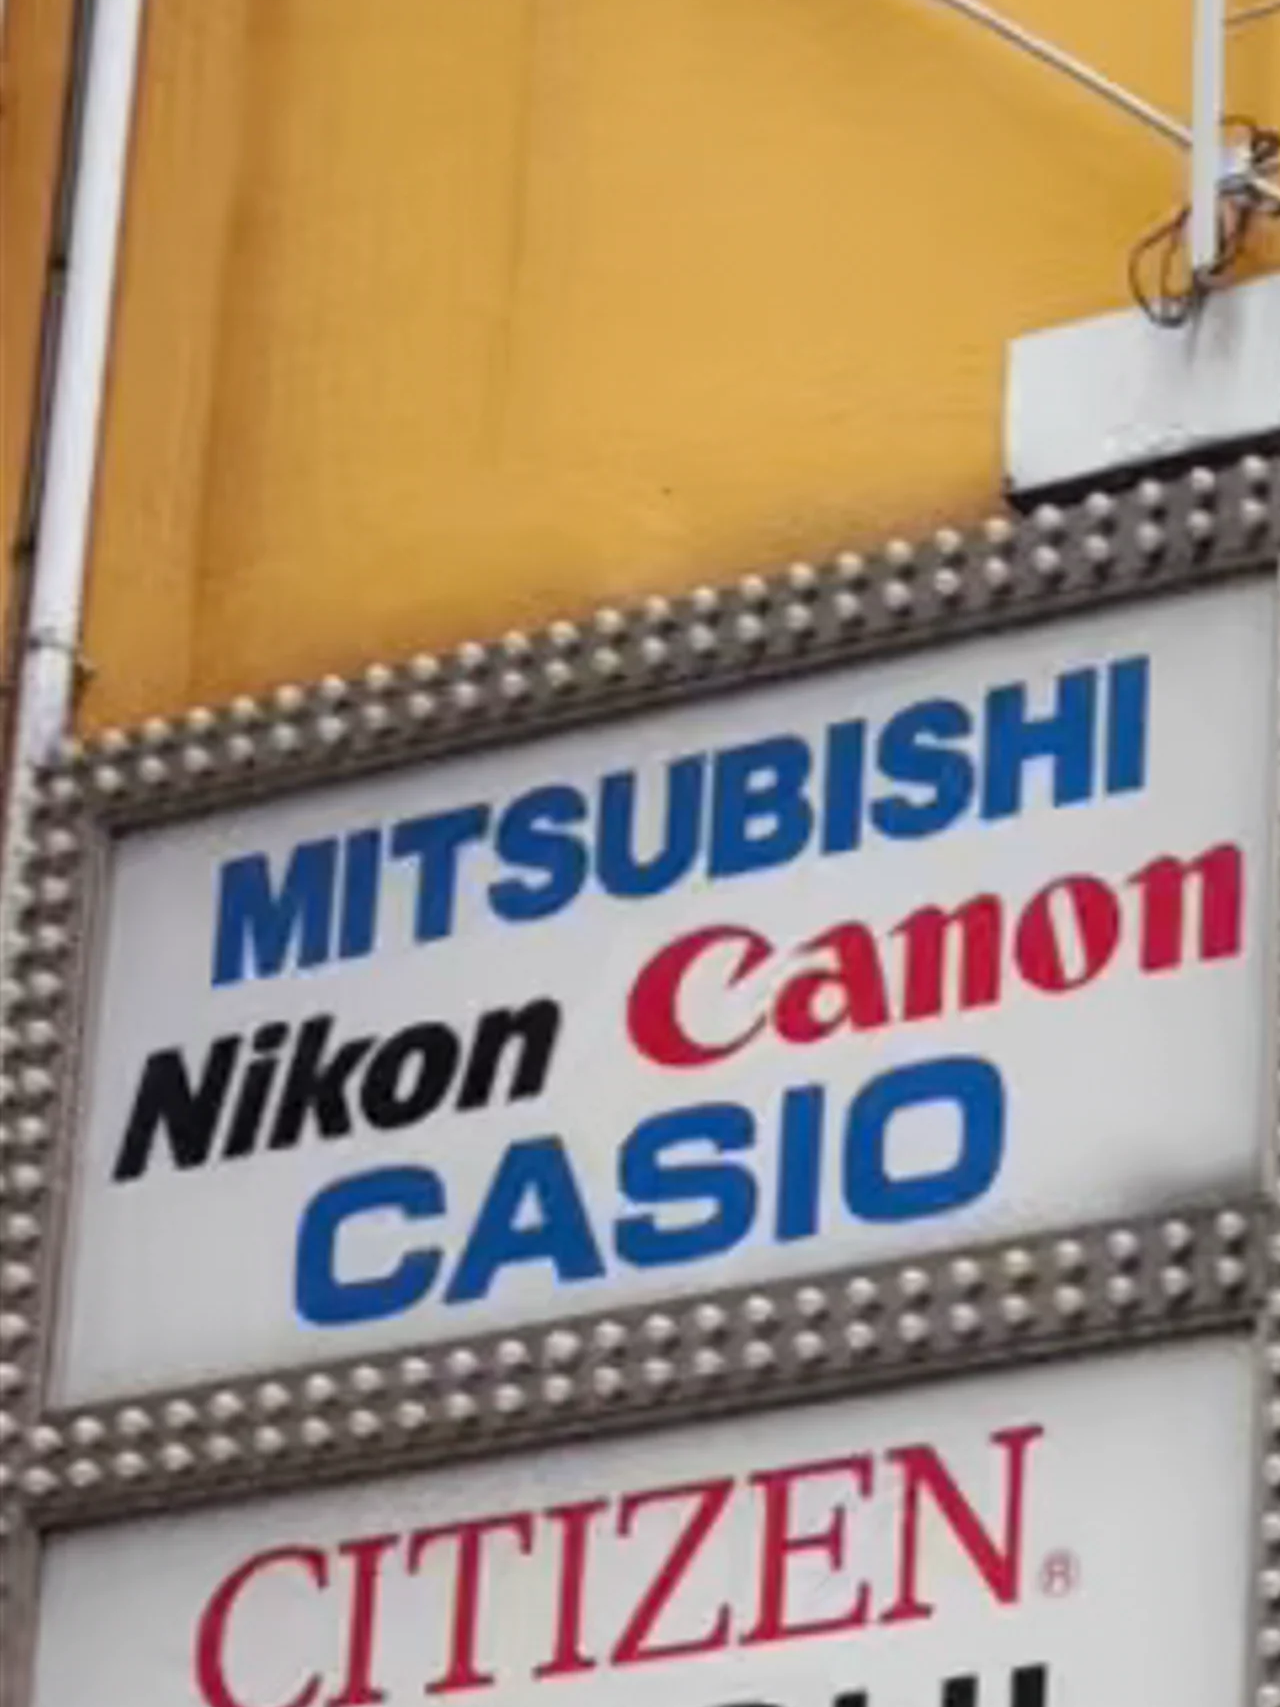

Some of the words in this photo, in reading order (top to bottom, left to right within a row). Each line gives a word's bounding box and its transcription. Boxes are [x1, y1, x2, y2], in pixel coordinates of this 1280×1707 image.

[210, 655, 1149, 987] MITSUBISHI
[112, 994, 561, 1182] Nikon
[624, 841, 1245, 1069] Canon
[293, 1055, 1002, 1328] CASIO
